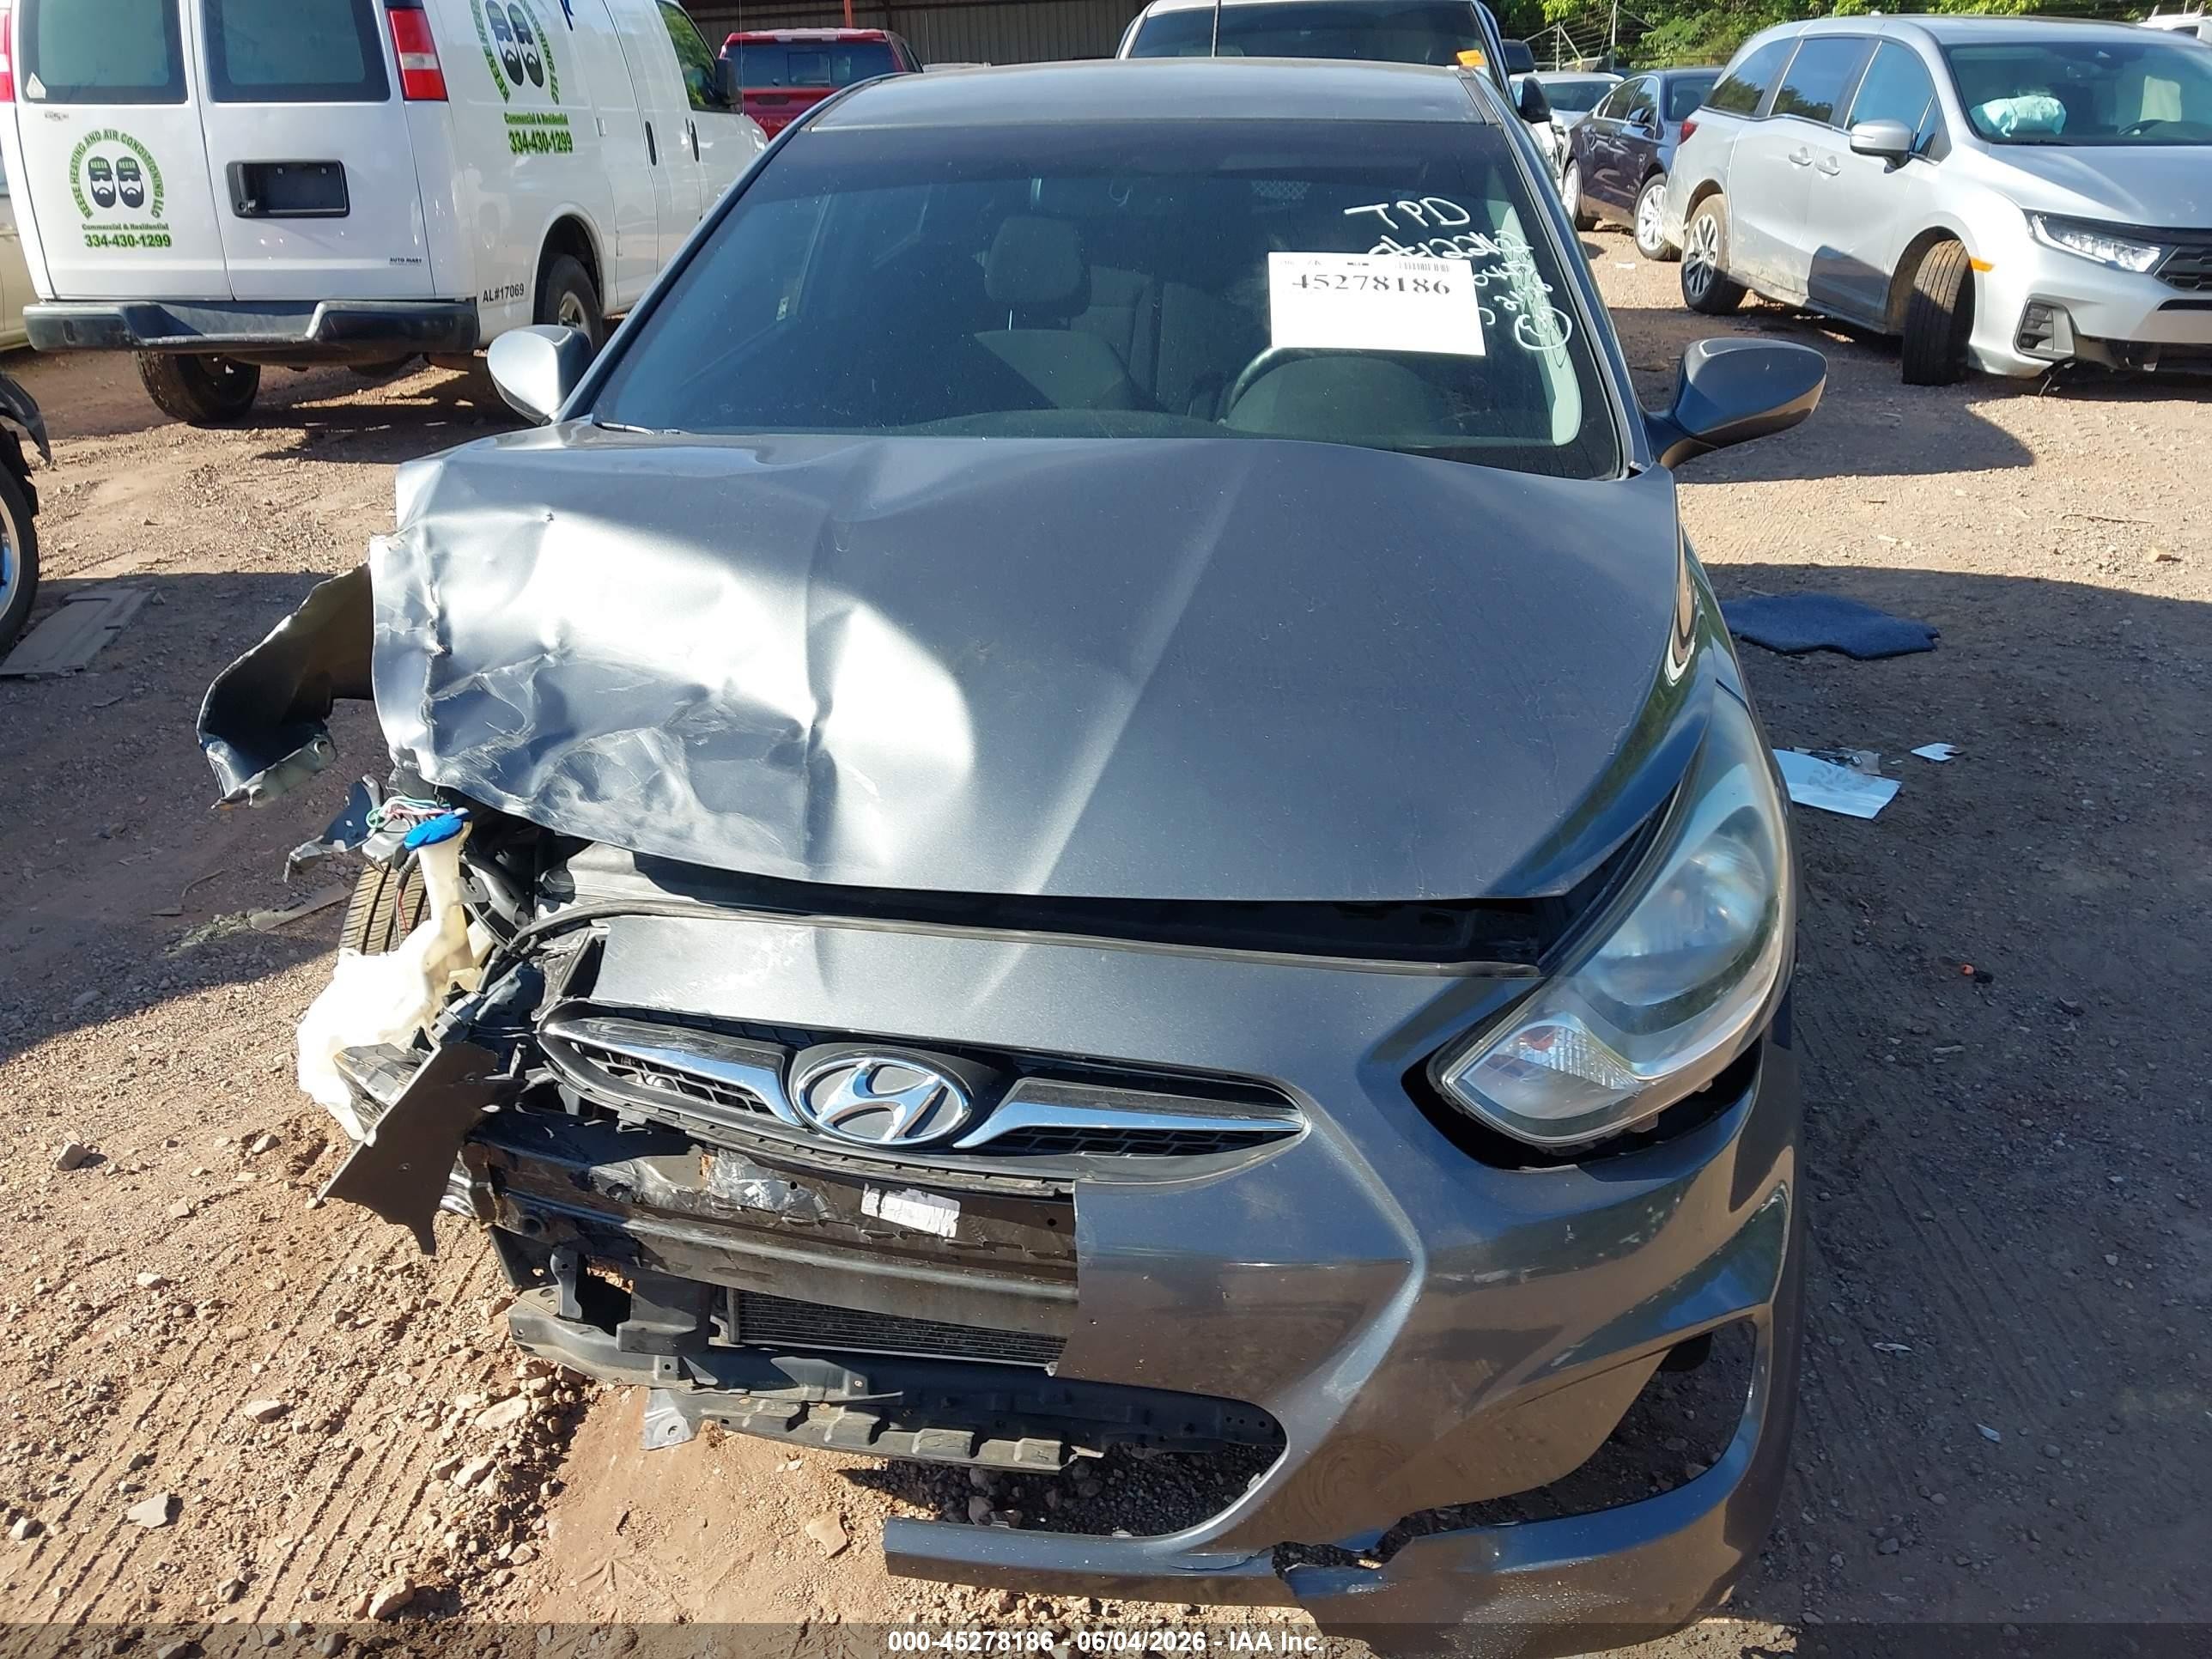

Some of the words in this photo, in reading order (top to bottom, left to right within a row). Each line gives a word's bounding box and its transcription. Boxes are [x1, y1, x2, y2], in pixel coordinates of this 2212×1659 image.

[83, 131, 102, 147] AND
[102, 129, 119, 141] AIR
[508, 131, 573, 154] 334-430-1299
[70, 143, 86, 184] HEATING
[119, 132, 165, 198] CONDITIONING
[71, 185, 94, 220] REESE
[150, 198, 164, 219] LLC
[85, 234, 172, 247] 334-430-1299
[483, 283, 525, 303] AL#17069
[1291, 274, 1451, 295] 45278186
